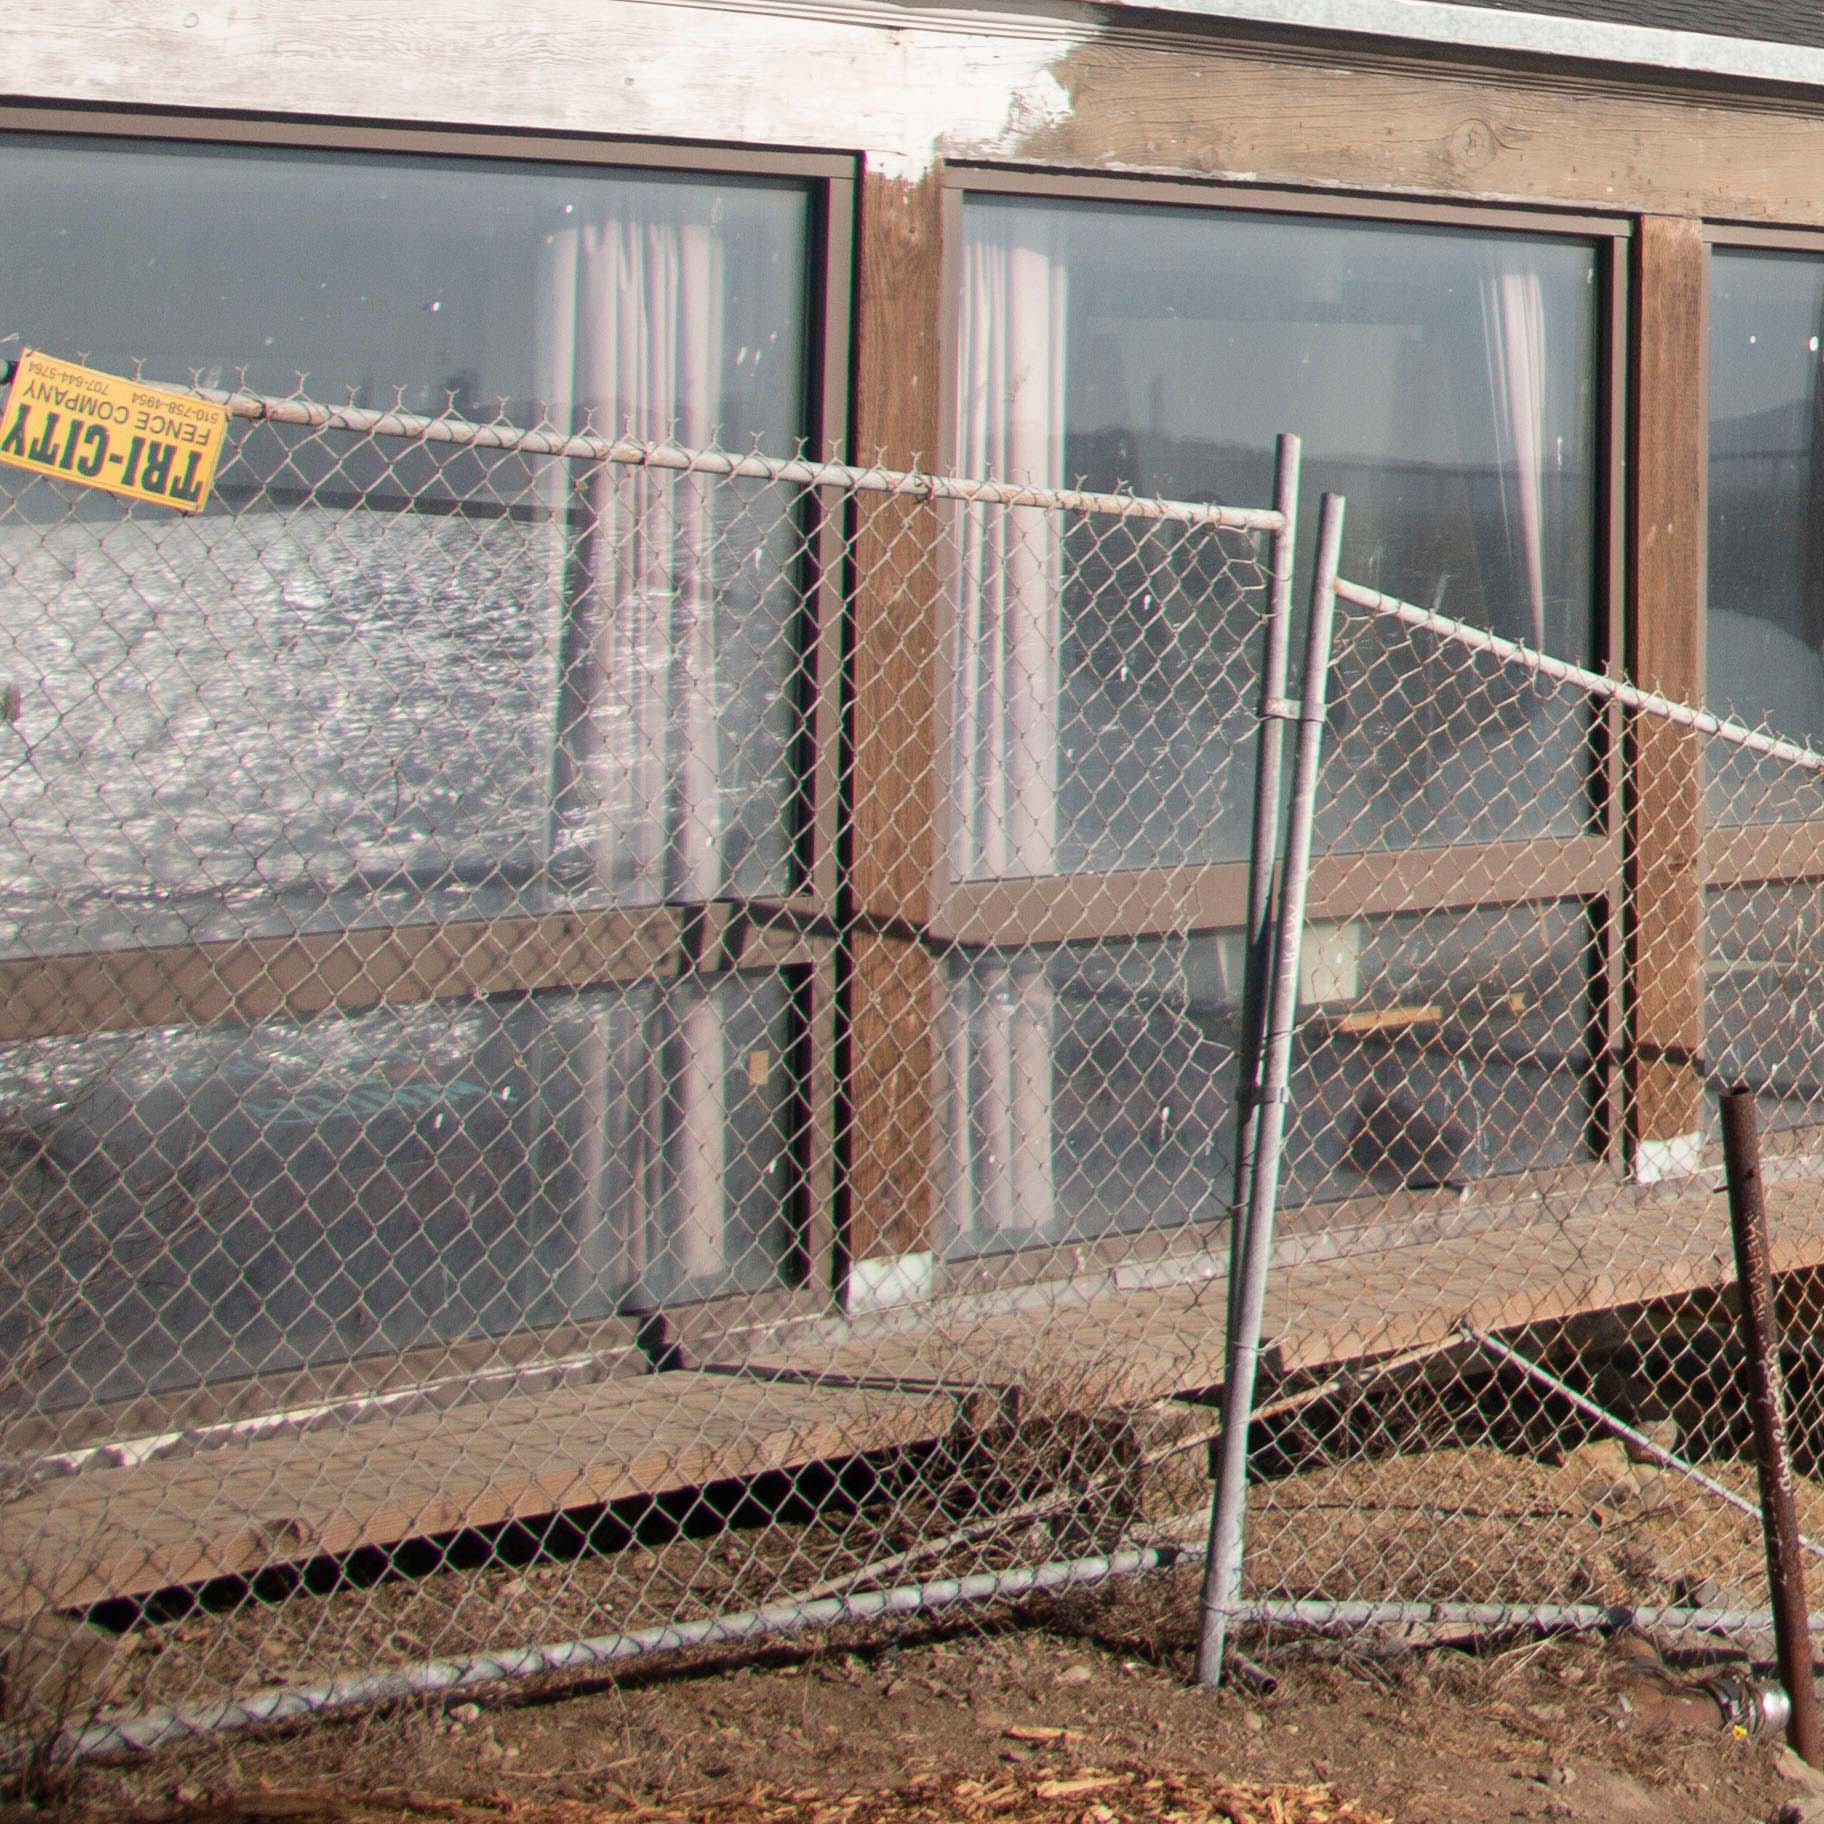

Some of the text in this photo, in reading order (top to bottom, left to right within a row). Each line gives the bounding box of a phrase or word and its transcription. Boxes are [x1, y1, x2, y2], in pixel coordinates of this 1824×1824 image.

[0, 403, 203, 503] TRI-CITY
[23, 379, 212, 446] FENCE COMPANY
